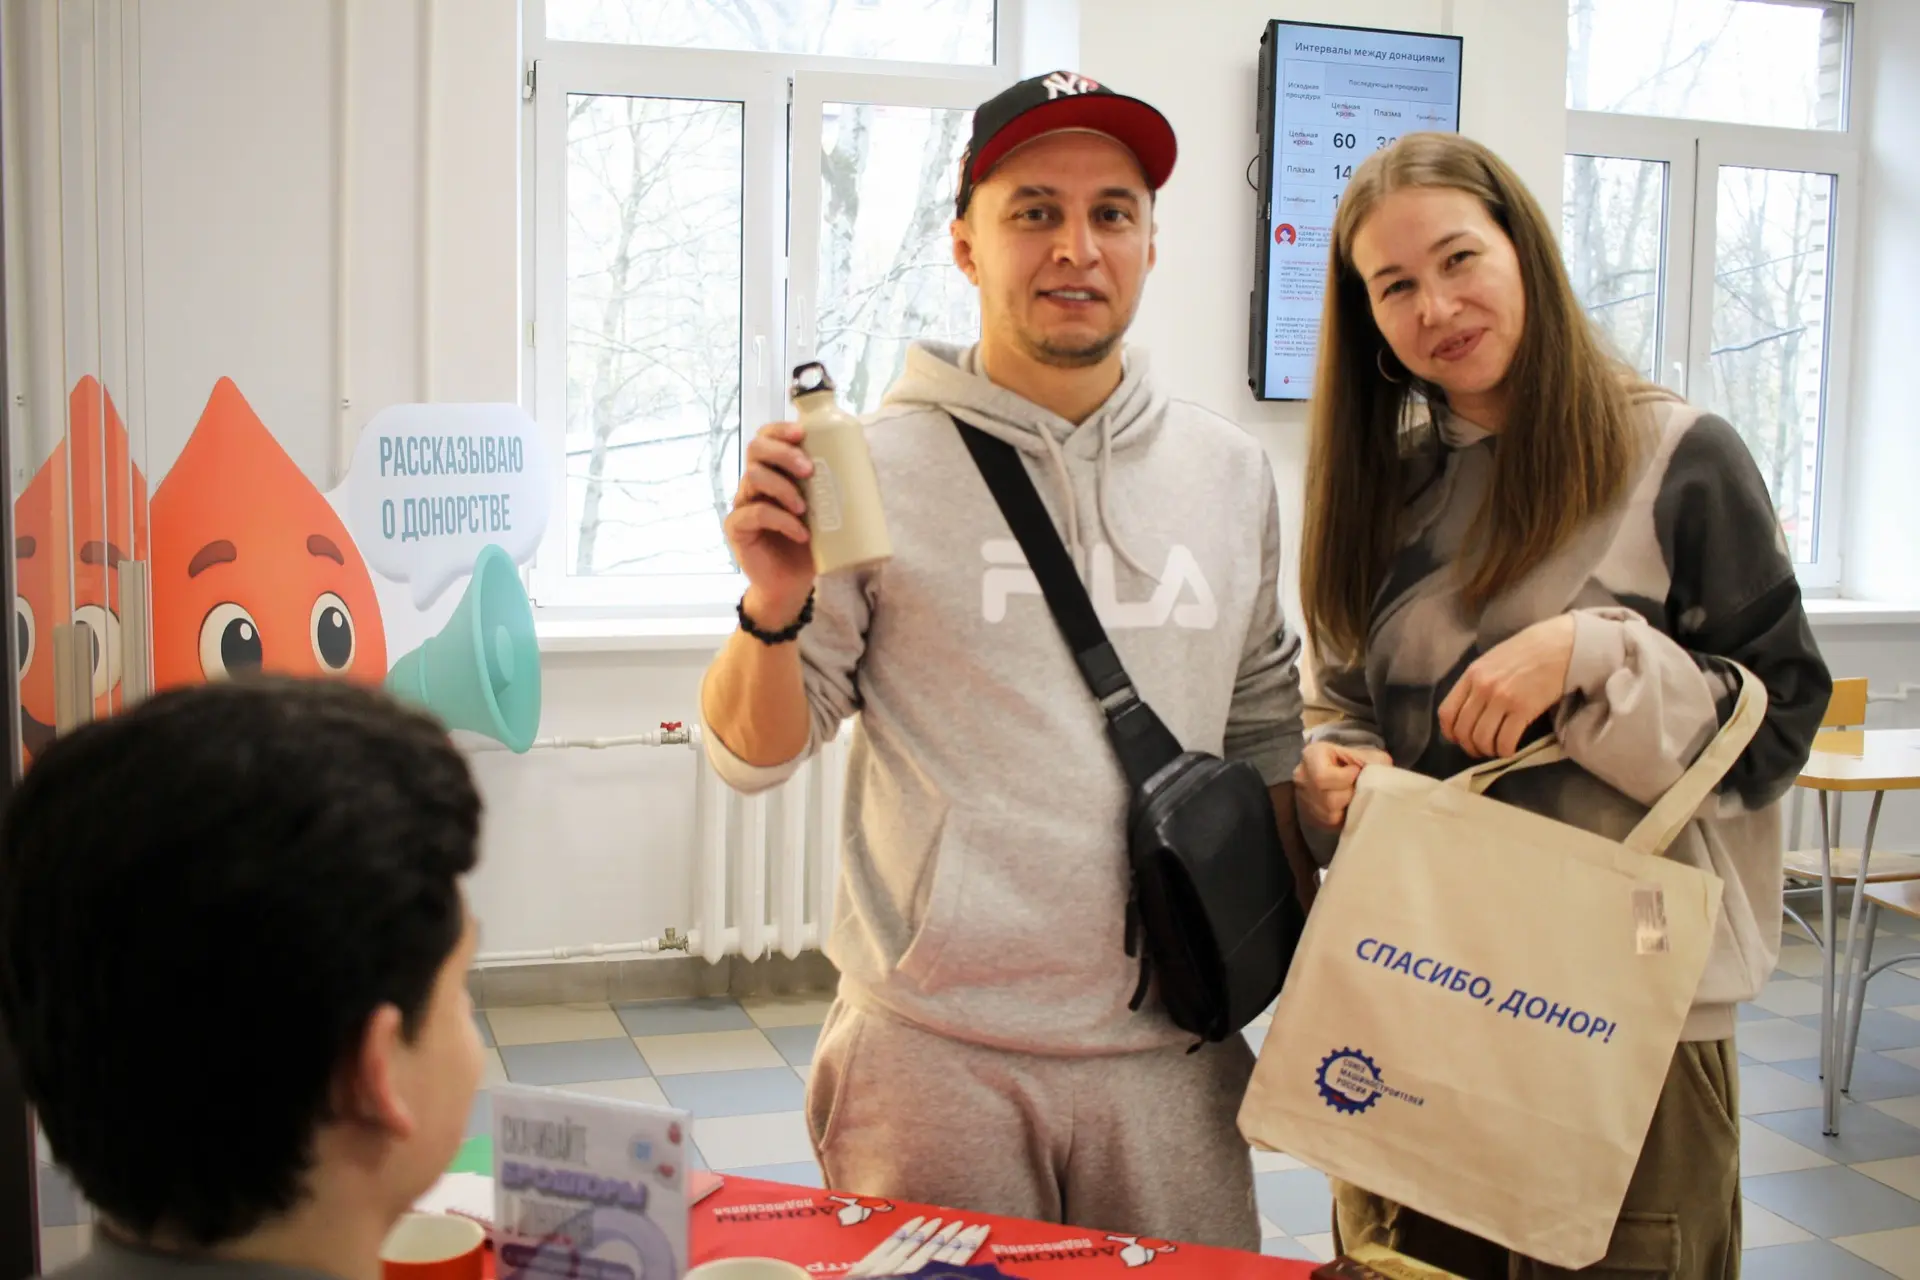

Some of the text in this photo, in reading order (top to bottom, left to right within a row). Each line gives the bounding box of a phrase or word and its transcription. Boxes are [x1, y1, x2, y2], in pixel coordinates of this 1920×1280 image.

[1295, 42, 1446, 64] Интервалы между донациями
[1287, 81, 1320, 90] Исходная
[1348, 79, 1394, 90] Последующая
[1286, 91, 1321, 101] процедура
[1331, 102, 1361, 110] Цельная
[1373, 108, 1402, 118] Плазма
[1289, 130, 1319, 138] Цельная
[1333, 132, 1357, 149] 60
[1286, 164, 1316, 174] Плазма
[1333, 164, 1352, 180] 14
[379, 435, 524, 477] РАССКАЗЫВАЮ
[381, 493, 512, 542] О ДОНОРСТВЕ
[980, 539, 1219, 630] FLA
[1355, 937, 1617, 1044] СПАСИБО, ДОНОР!
[1343, 1058, 1367, 1074] СОЮЗ
[1336, 1077, 1368, 1095] РОССИИ
[715, 1205, 836, 1224] ДОНОРЫ
[996, 1245, 1116, 1264] ДОНОРЫ
